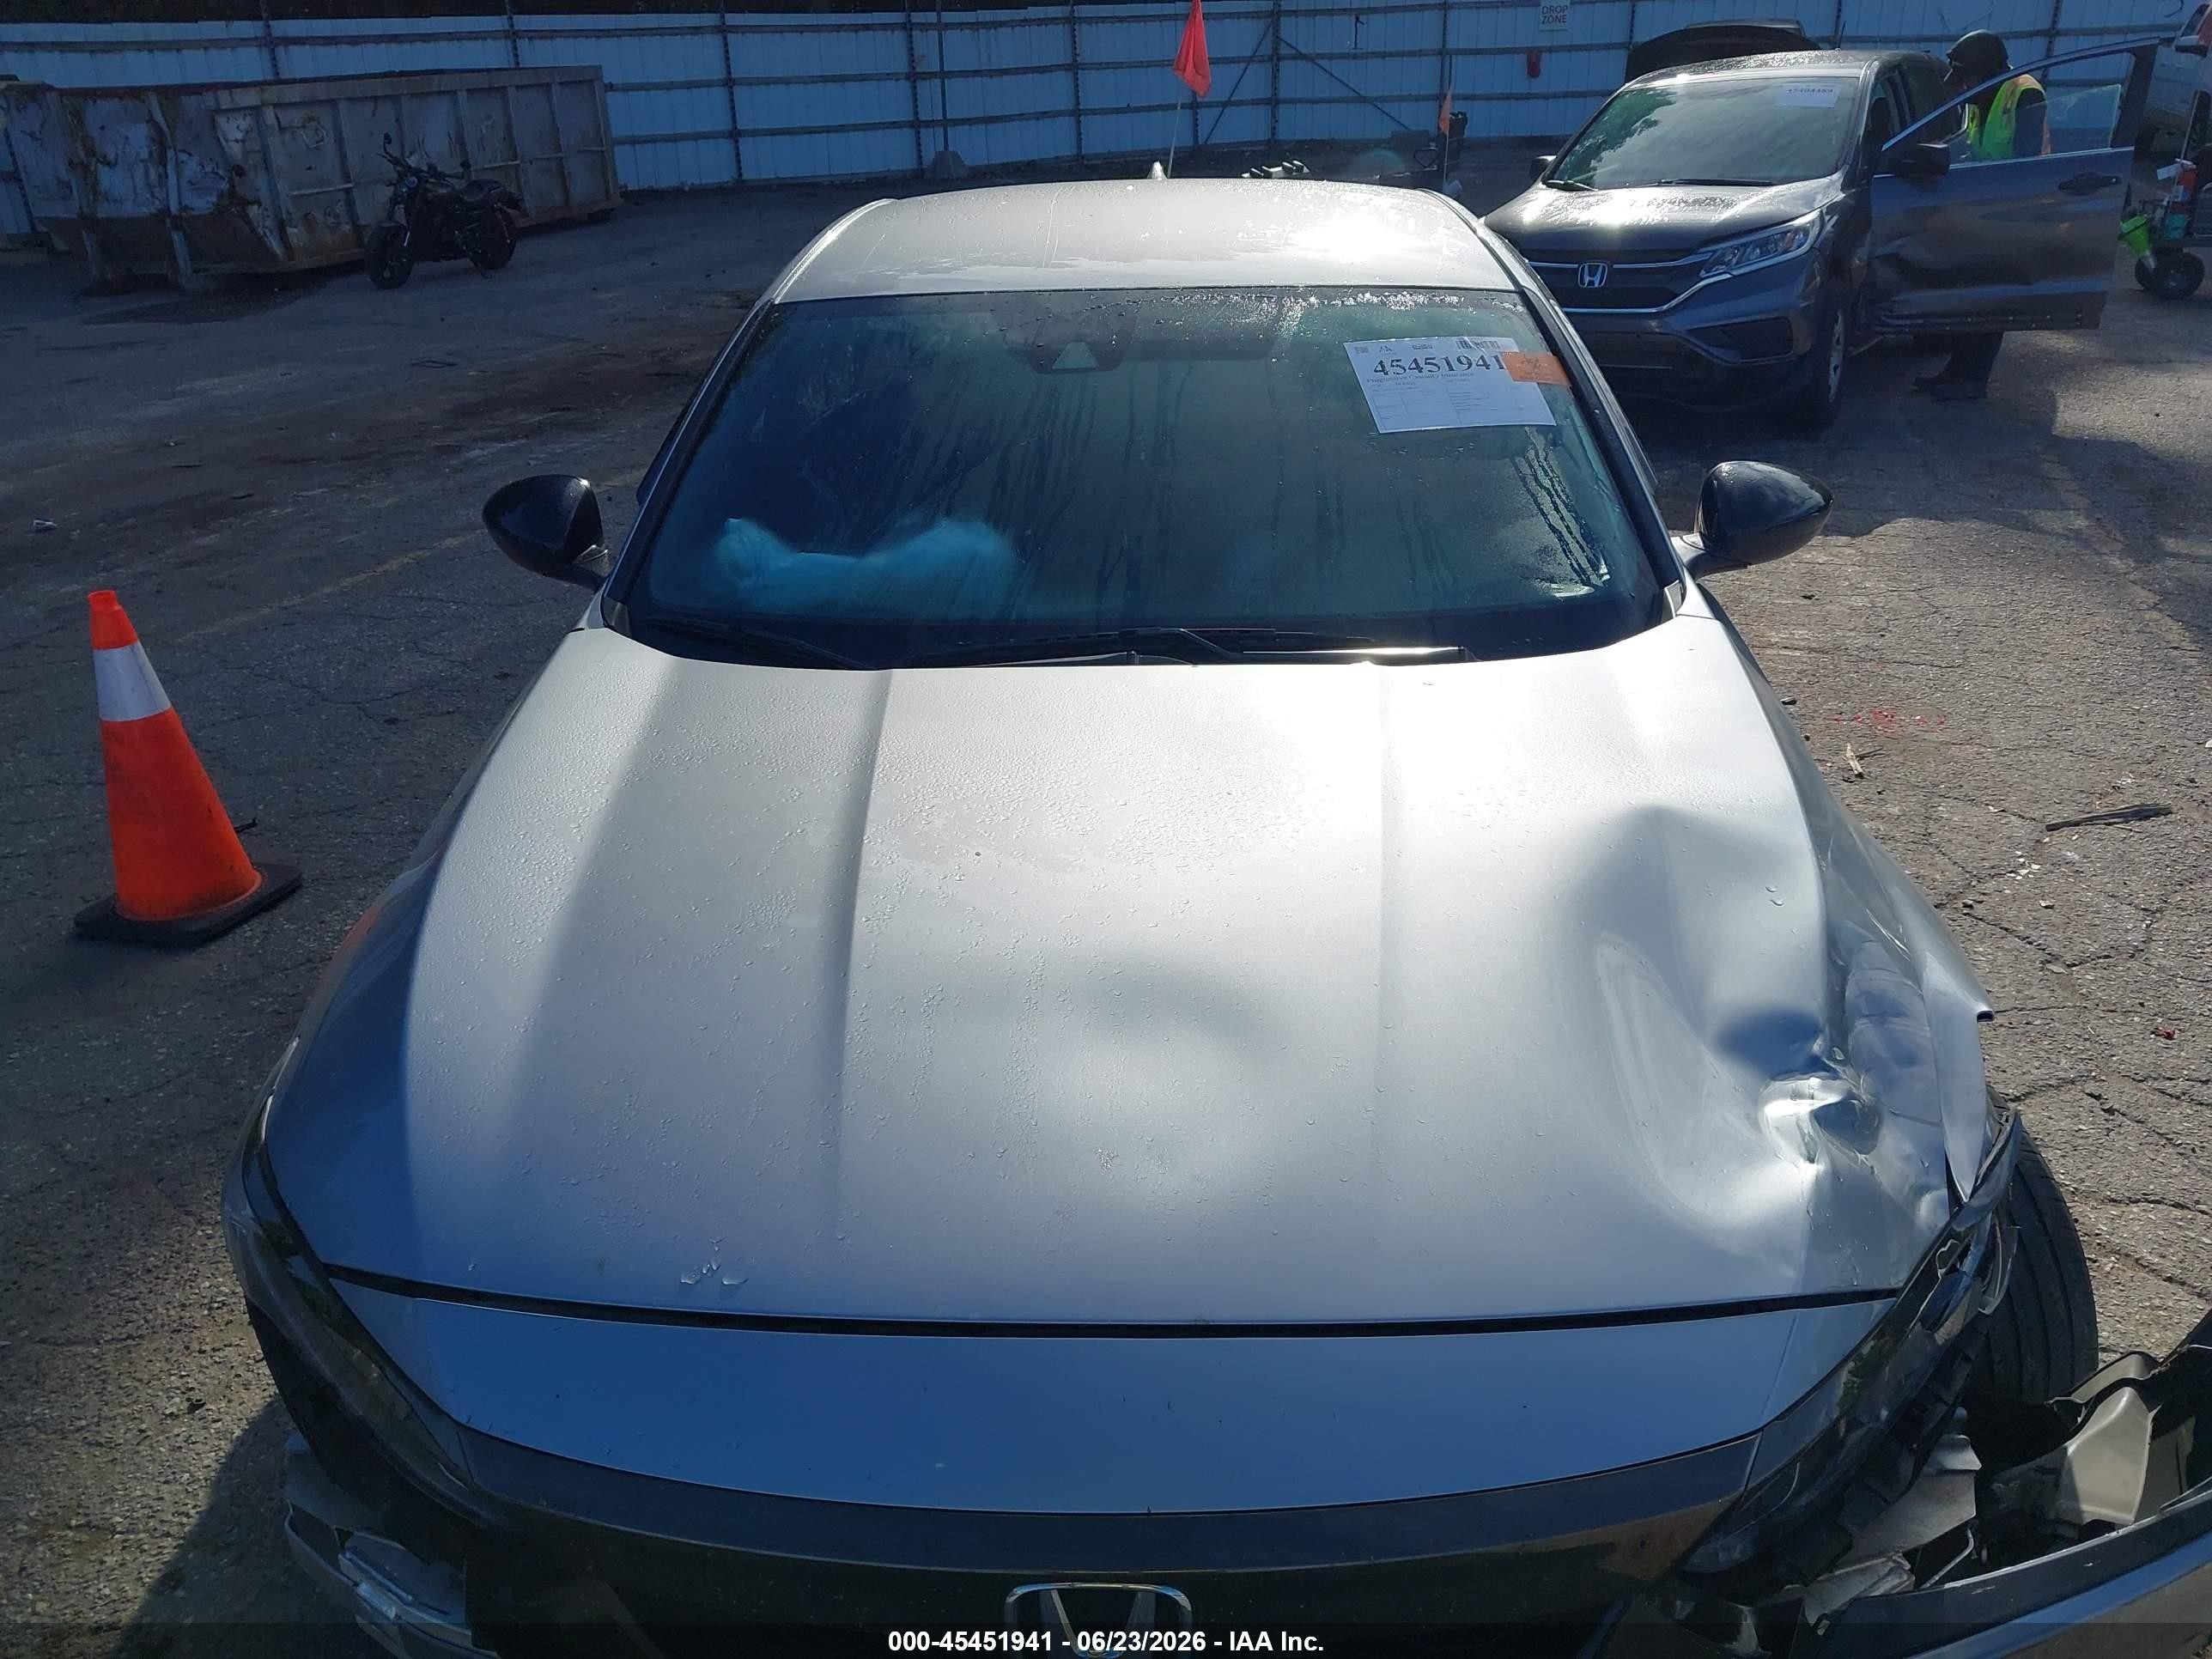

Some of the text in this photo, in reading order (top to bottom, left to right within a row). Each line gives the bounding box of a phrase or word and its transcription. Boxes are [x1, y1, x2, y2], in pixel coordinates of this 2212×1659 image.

[1541, 5, 1568, 15] DROP
[1541, 14, 1567, 24] ZONE
[1374, 354, 1505, 375] 45451941
